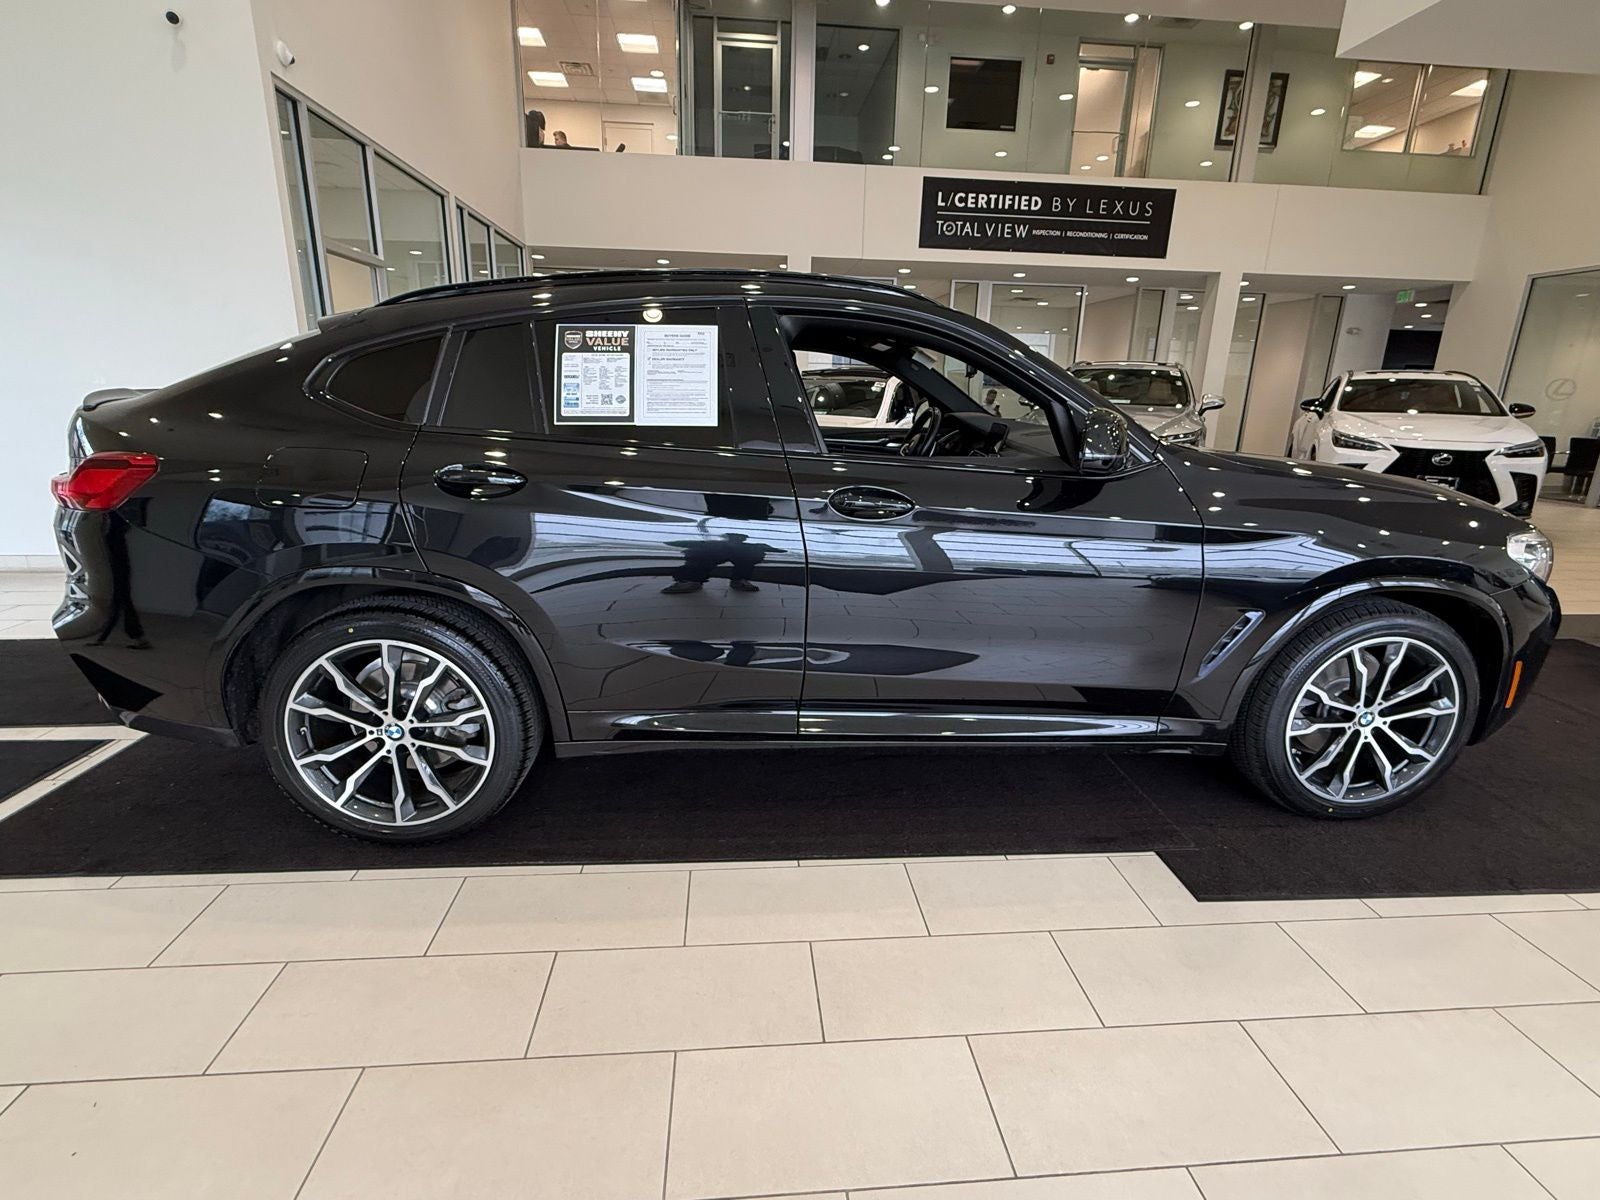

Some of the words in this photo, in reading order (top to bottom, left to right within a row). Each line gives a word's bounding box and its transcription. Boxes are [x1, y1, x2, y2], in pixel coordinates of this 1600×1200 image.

[937, 191, 1042, 211] L/CERTIFIED
[1051, 197, 1077, 213] BY
[1086, 199, 1153, 217] LEXUS
[936, 220, 981, 237] TOTAL
[985, 222, 1029, 238] VIEW
[585, 338, 629, 346] VALUE
